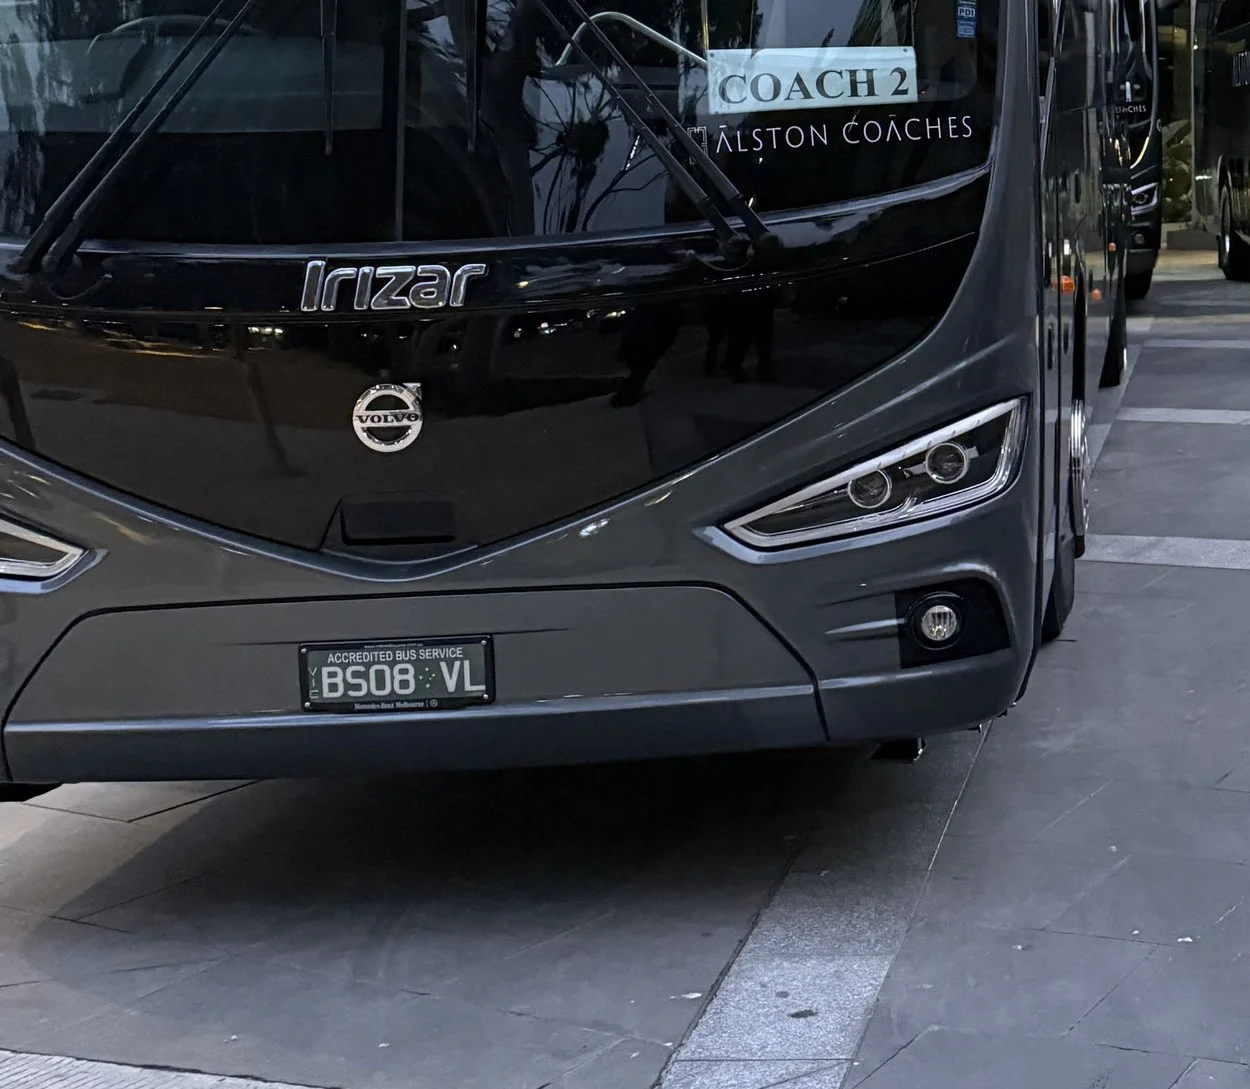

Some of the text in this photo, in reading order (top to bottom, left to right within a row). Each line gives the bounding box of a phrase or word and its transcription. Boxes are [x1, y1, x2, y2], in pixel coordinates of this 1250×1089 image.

[718, 66, 910, 105] COACH 2
[301, 260, 487, 311] Irizar
[354, 412, 421, 425] VOLVO
[327, 647, 463, 664] ACCREDITED BUS SERVICE
[321, 660, 486, 699] BS08 VL
